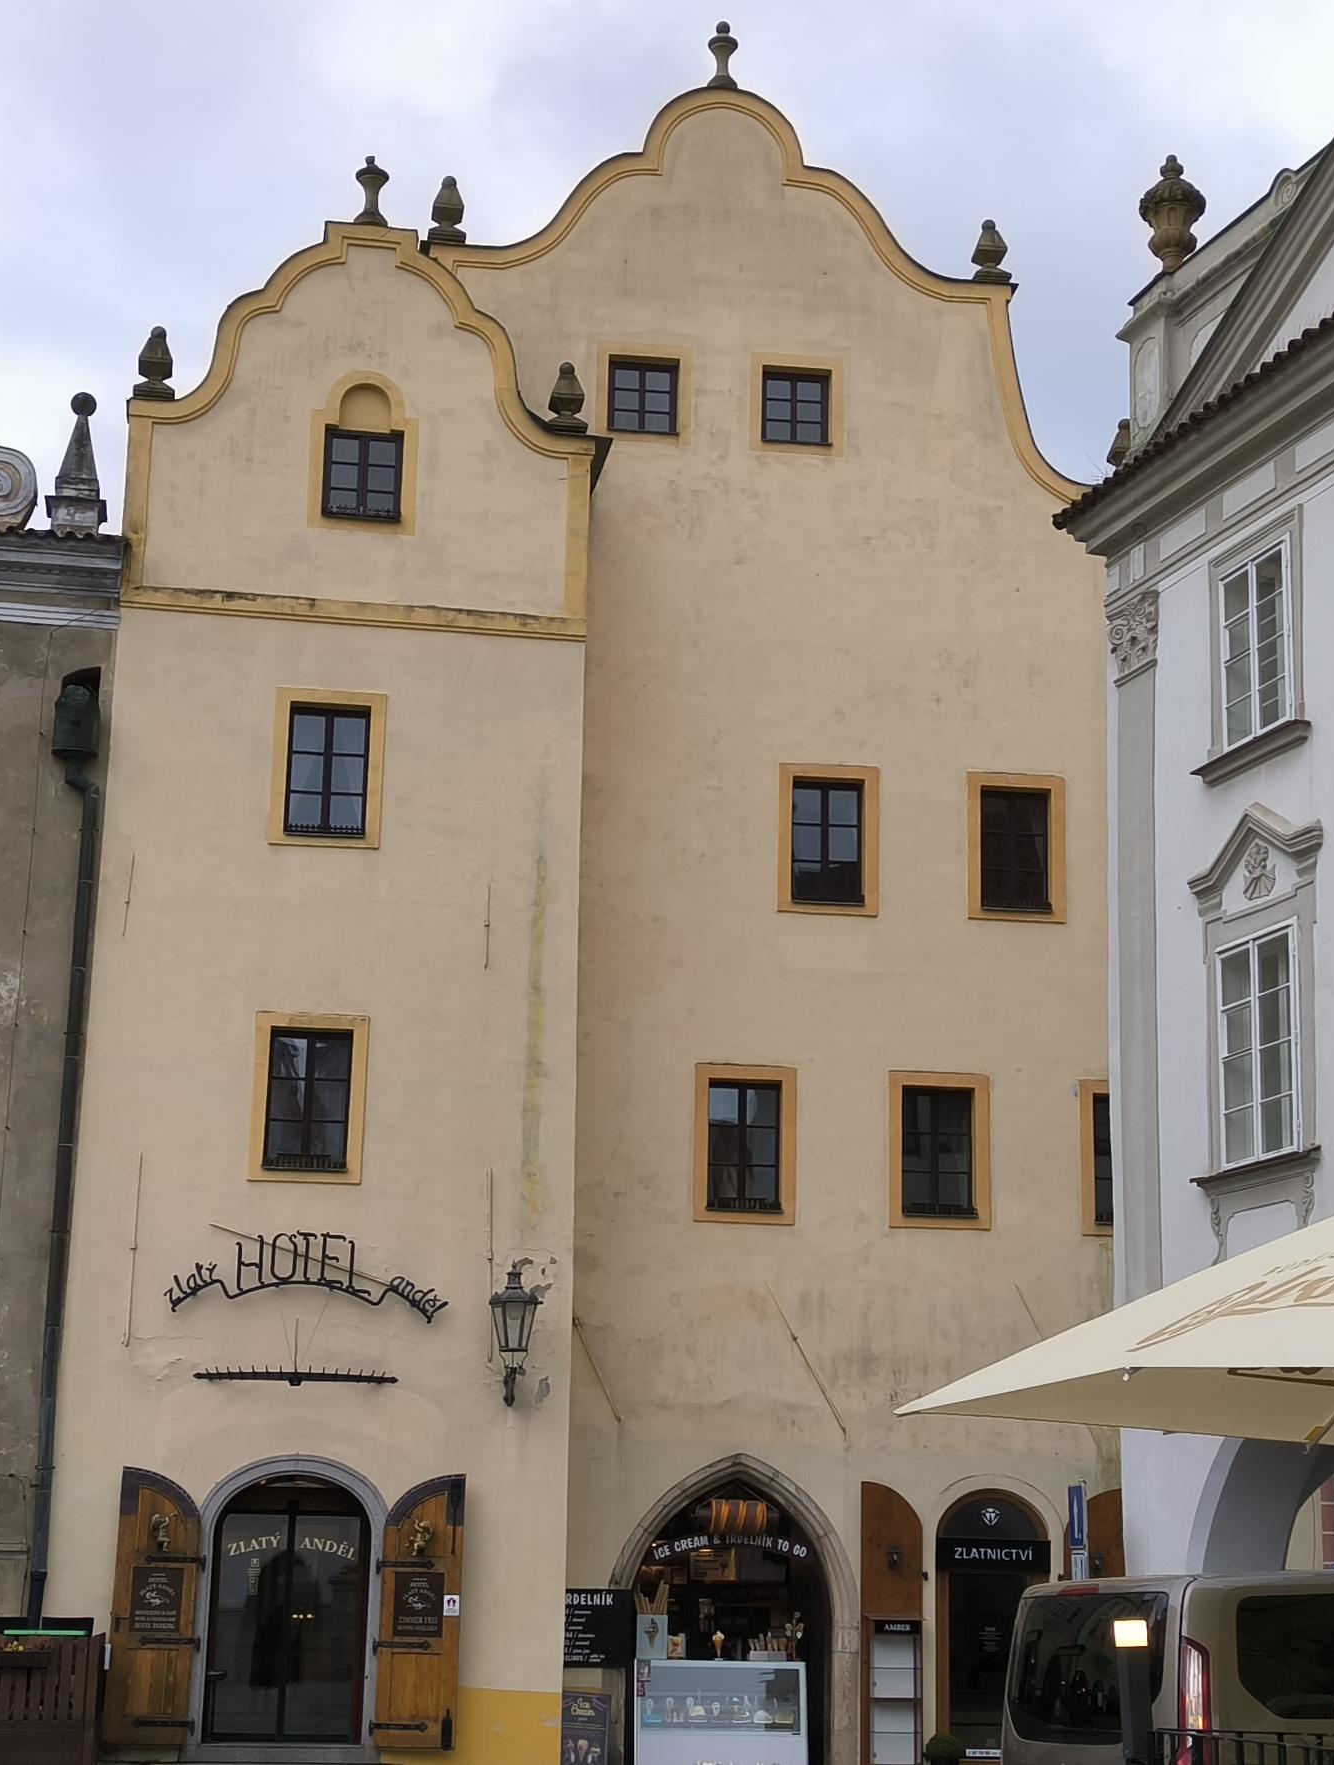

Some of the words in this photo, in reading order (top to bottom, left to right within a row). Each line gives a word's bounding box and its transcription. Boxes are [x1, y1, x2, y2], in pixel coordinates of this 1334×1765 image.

[235, 1230, 372, 1299] HOTEL
[227, 1531, 283, 1556] ZLATÝ
[300, 1536, 356, 1561] ANDĚL
[653, 1544, 672, 1560] ICE
[674, 1535, 709, 1552] CREAM
[777, 1539, 790, 1552] TO
[793, 1544, 808, 1558] GO
[954, 1547, 1033, 1561] ZLATNICTVÍ
[564, 1591, 614, 1606] RDELNÍK
[883, 1623, 912, 1632] AMBER
